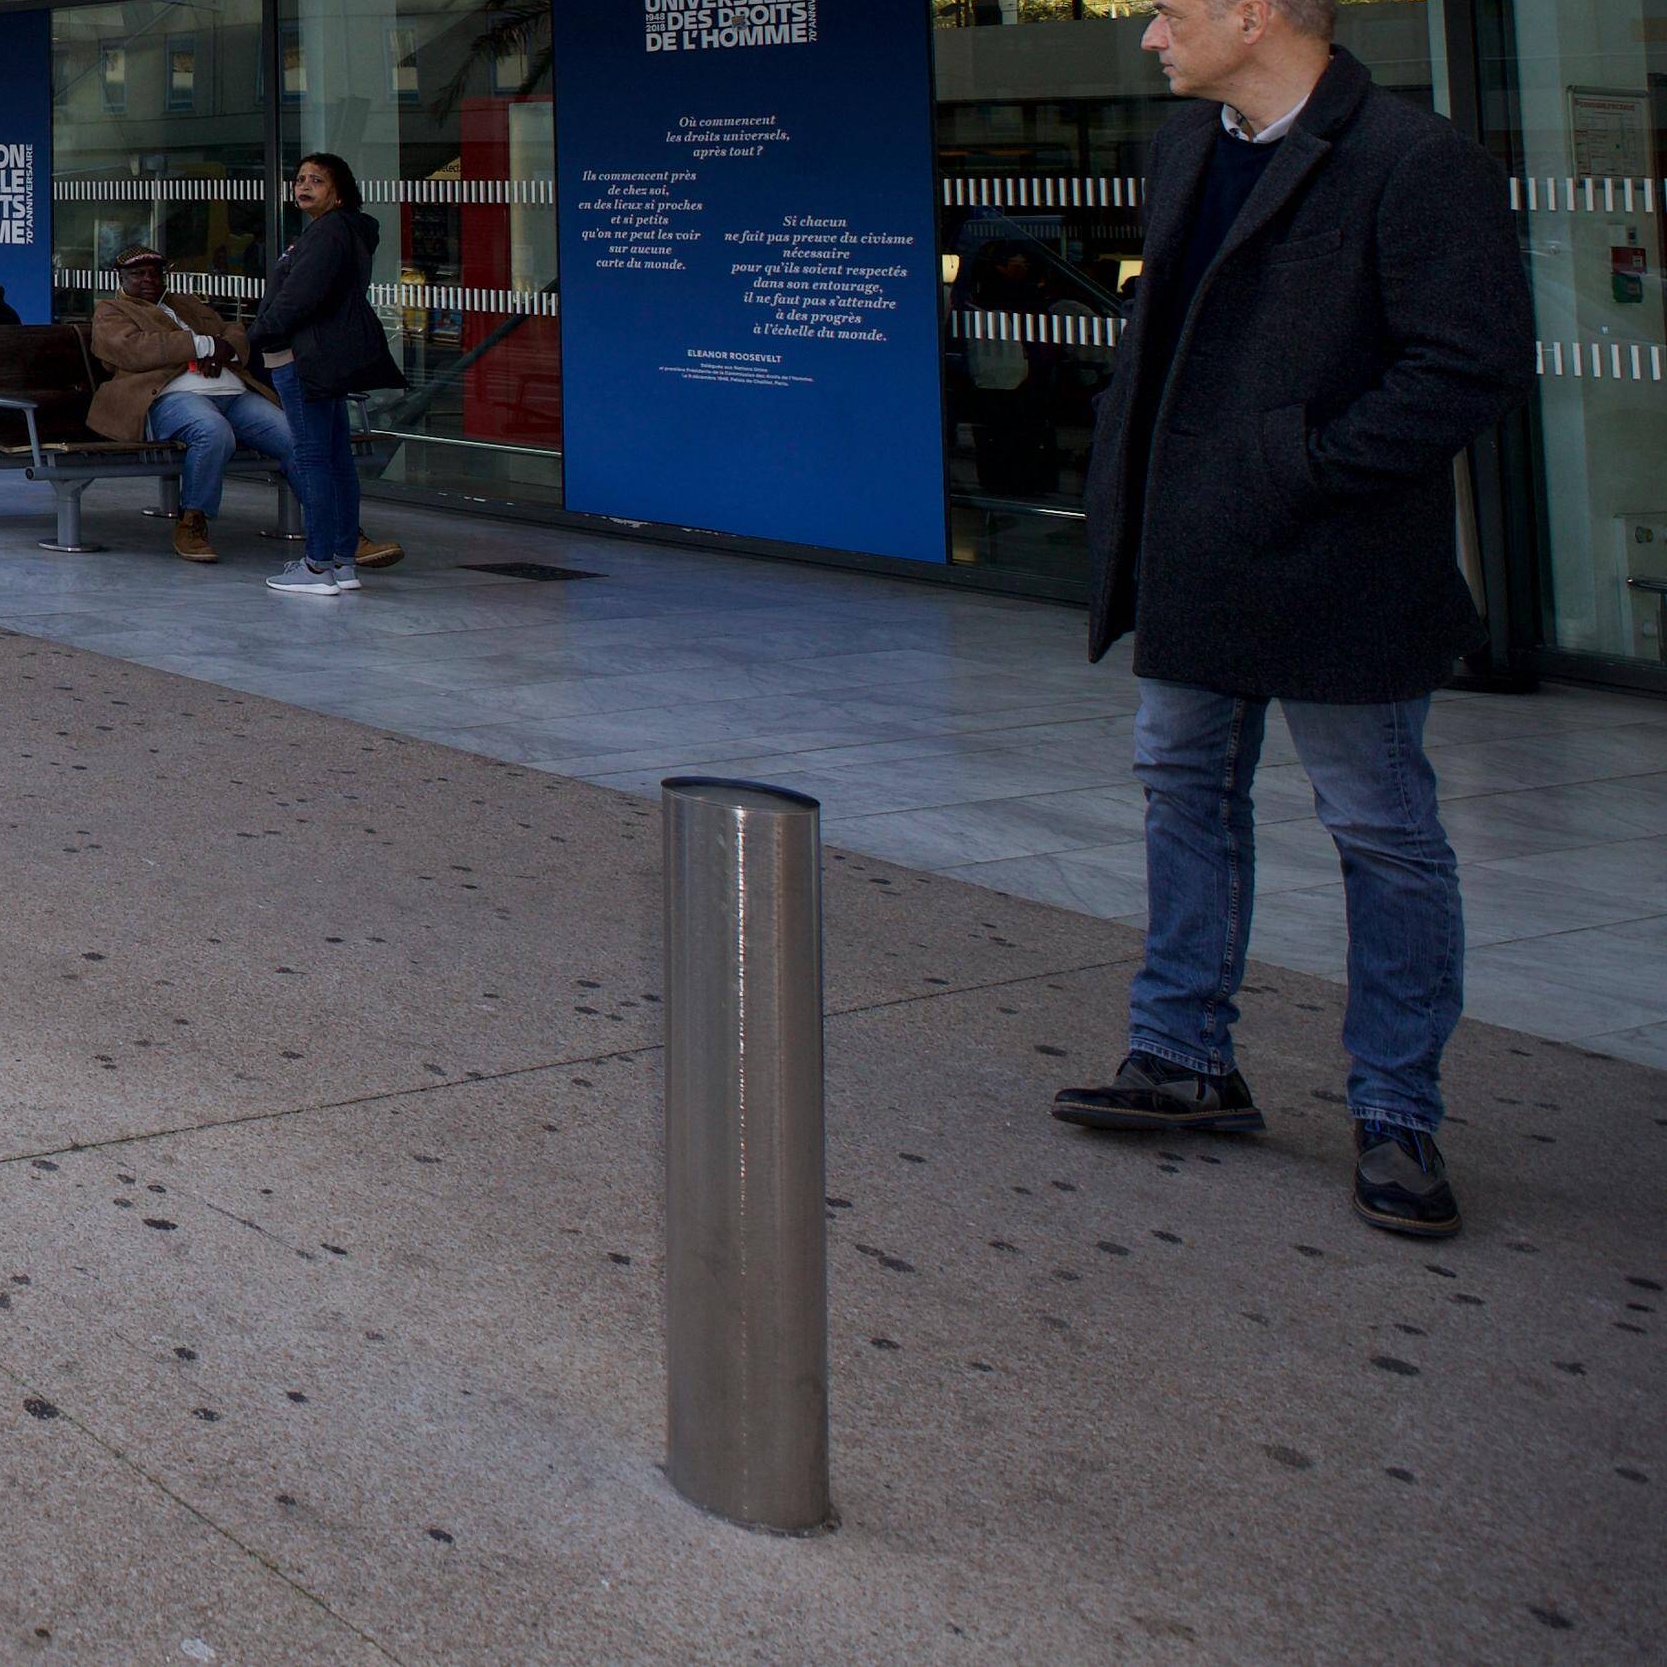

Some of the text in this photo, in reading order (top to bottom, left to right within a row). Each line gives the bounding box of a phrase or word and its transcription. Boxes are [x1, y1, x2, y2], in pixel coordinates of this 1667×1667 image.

[645, 13, 665, 22] 1948
[667, 2, 807, 31] DES DROITS
[646, 23, 666, 32] 2018
[646, 31, 677, 53] DE
[678, 115, 776, 128] Où commencent
[666, 129, 790, 143] les droits universels,
[693, 146, 727, 159] après
[582, 170, 697, 183] Ils commencent près
[607, 185, 621, 195] de
[622, 185, 647, 195] chez
[578, 200, 703, 213] en des lieux si proches
[610, 214, 669, 227] et si petits
[782, 215, 847, 228] Si chacun
[581, 228, 701, 242] qu'on ne peut les voir
[724, 230, 914, 245] ne fait pas preuve du civisme
[608, 245, 672, 255] sur aucune
[782, 247, 850, 259] nécessaire
[596, 259, 686, 270] carte du monde.
[731, 261, 907, 279] pour qu'ils soient respectés
[753, 277, 883, 295] dans son entourage,
[743, 292, 896, 310] il ne faut pas s'attendre
[775, 308, 862, 325] à des progrès
[753, 322, 888, 342] à l'échelle du monde.
[687, 349, 783, 363] ELEANOR ROOSEVELT
